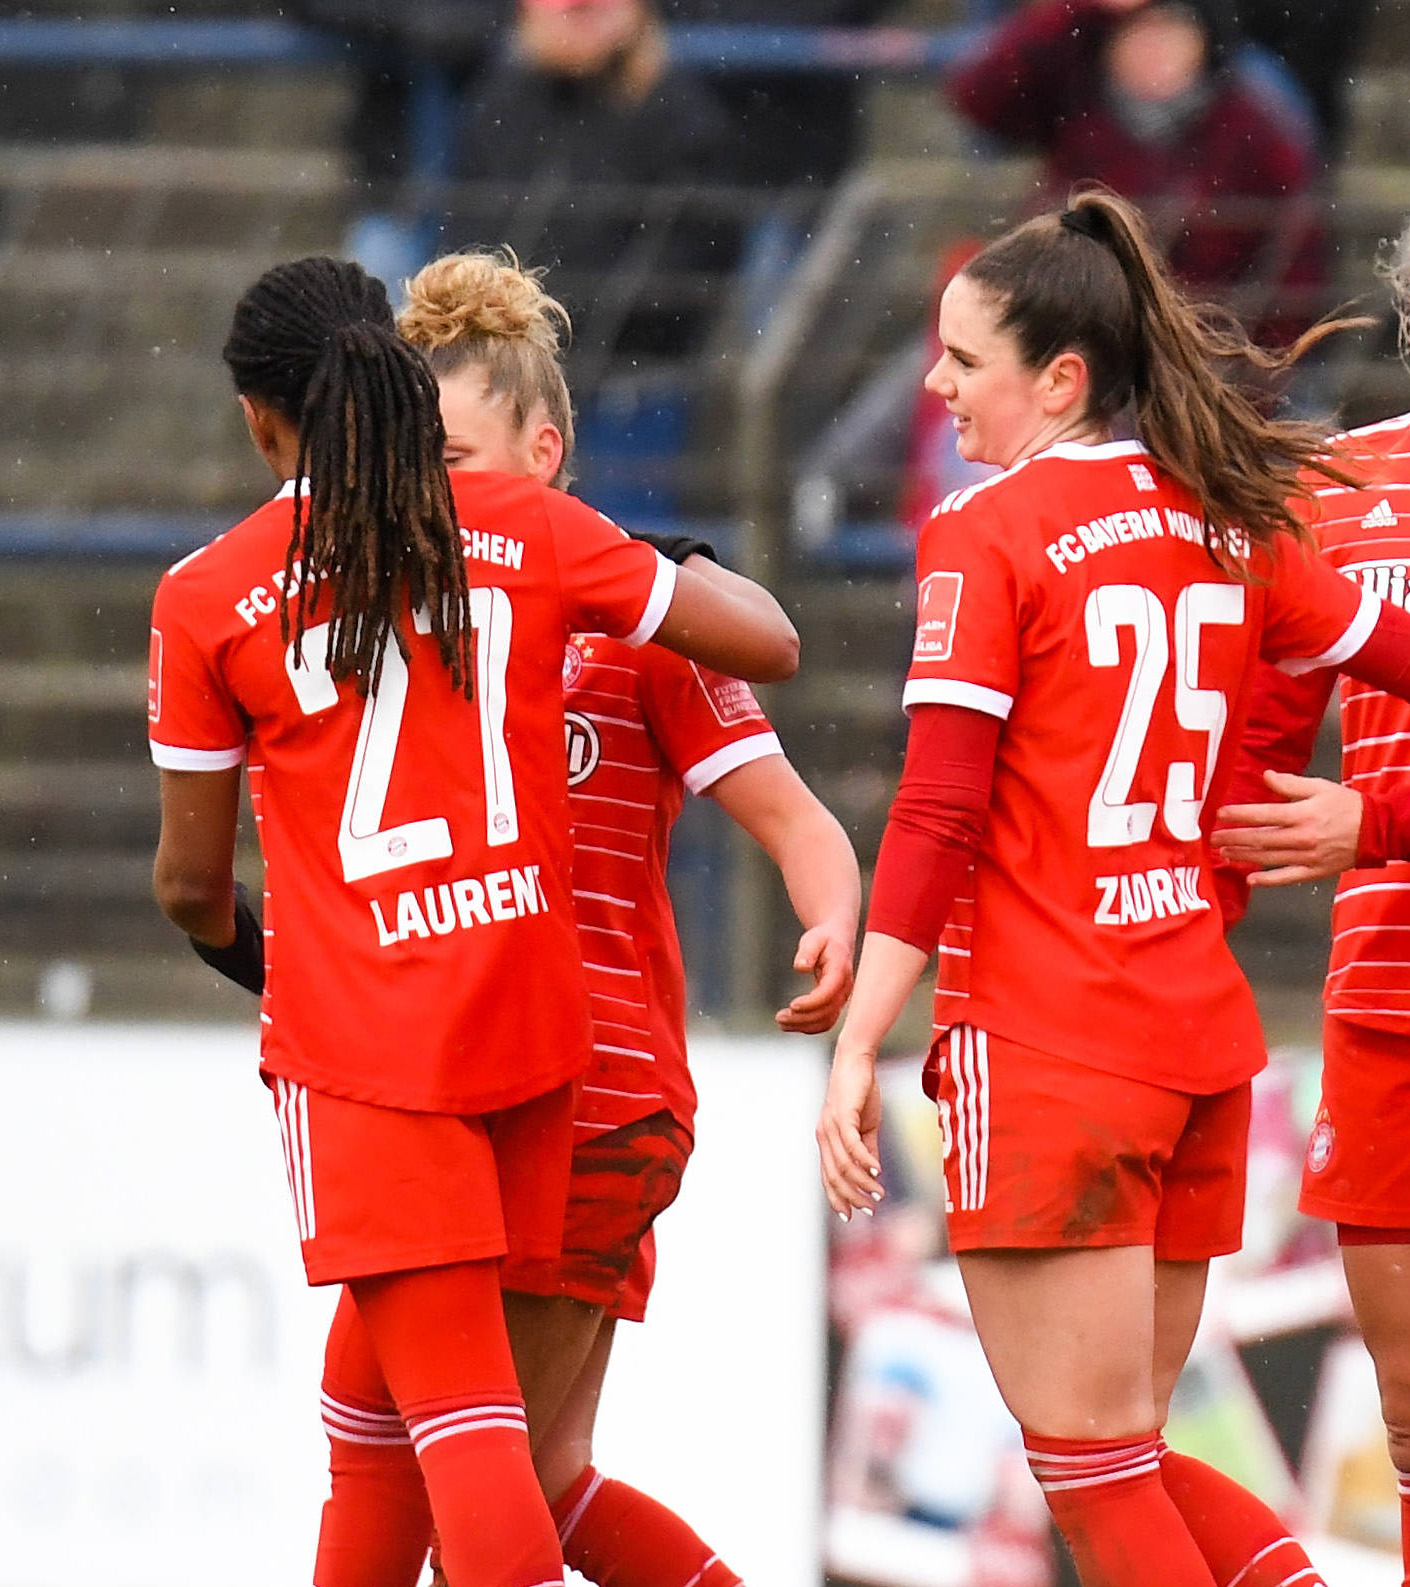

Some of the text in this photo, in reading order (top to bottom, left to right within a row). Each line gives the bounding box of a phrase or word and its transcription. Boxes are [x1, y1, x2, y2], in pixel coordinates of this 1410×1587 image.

[1045, 533, 1086, 574] FC
[1076, 507, 1164, 554] BAYERN
[235, 586, 277, 627] FC
[1084, 583, 1245, 847] 25
